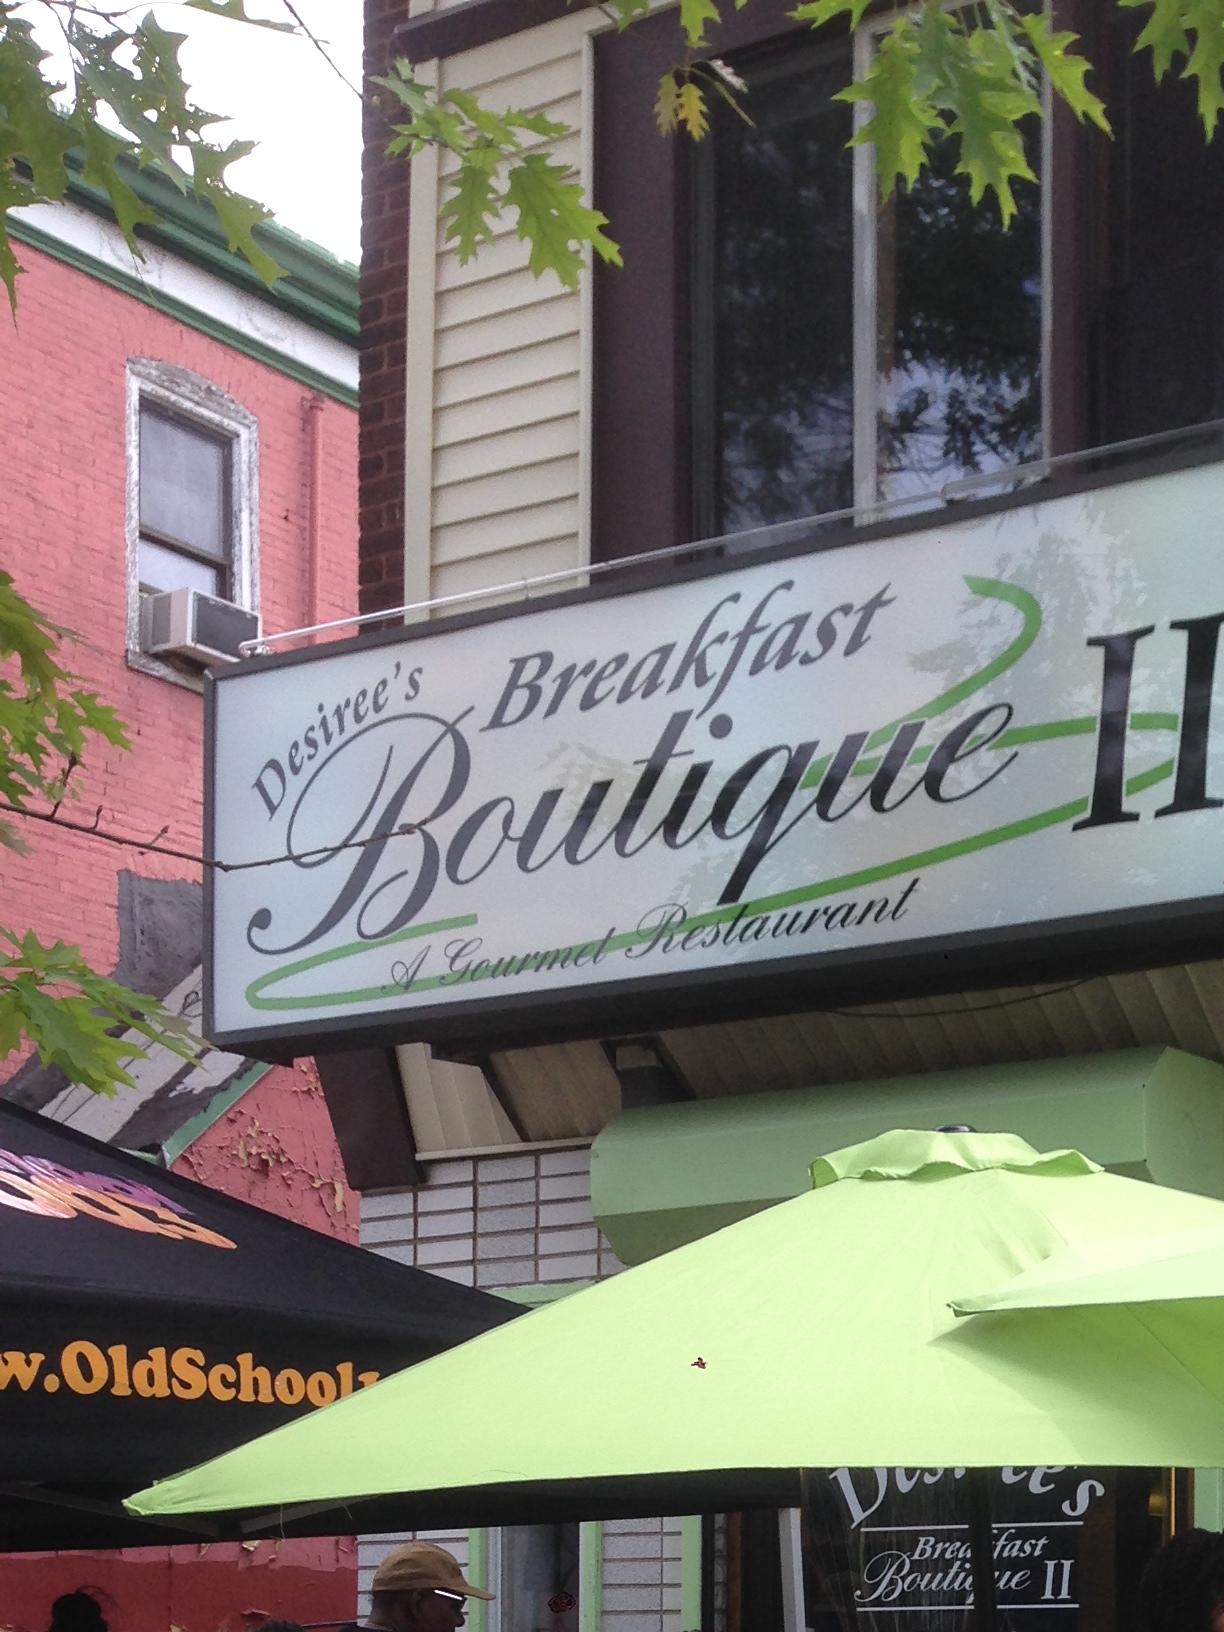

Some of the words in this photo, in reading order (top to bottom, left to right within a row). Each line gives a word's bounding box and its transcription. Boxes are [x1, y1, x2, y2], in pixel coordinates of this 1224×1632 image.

[480, 580, 896, 732] Breakfast
[253, 661, 423, 820] Desiree's
[247, 703, 1018, 954] Boutique
[382, 945, 431, 991] A
[439, 929, 615, 986] Gourmet
[625, 879, 920, 959] Restaurant
[910, 1529, 1049, 1560] Breafast
[1041, 1559, 1075, 1599] II
